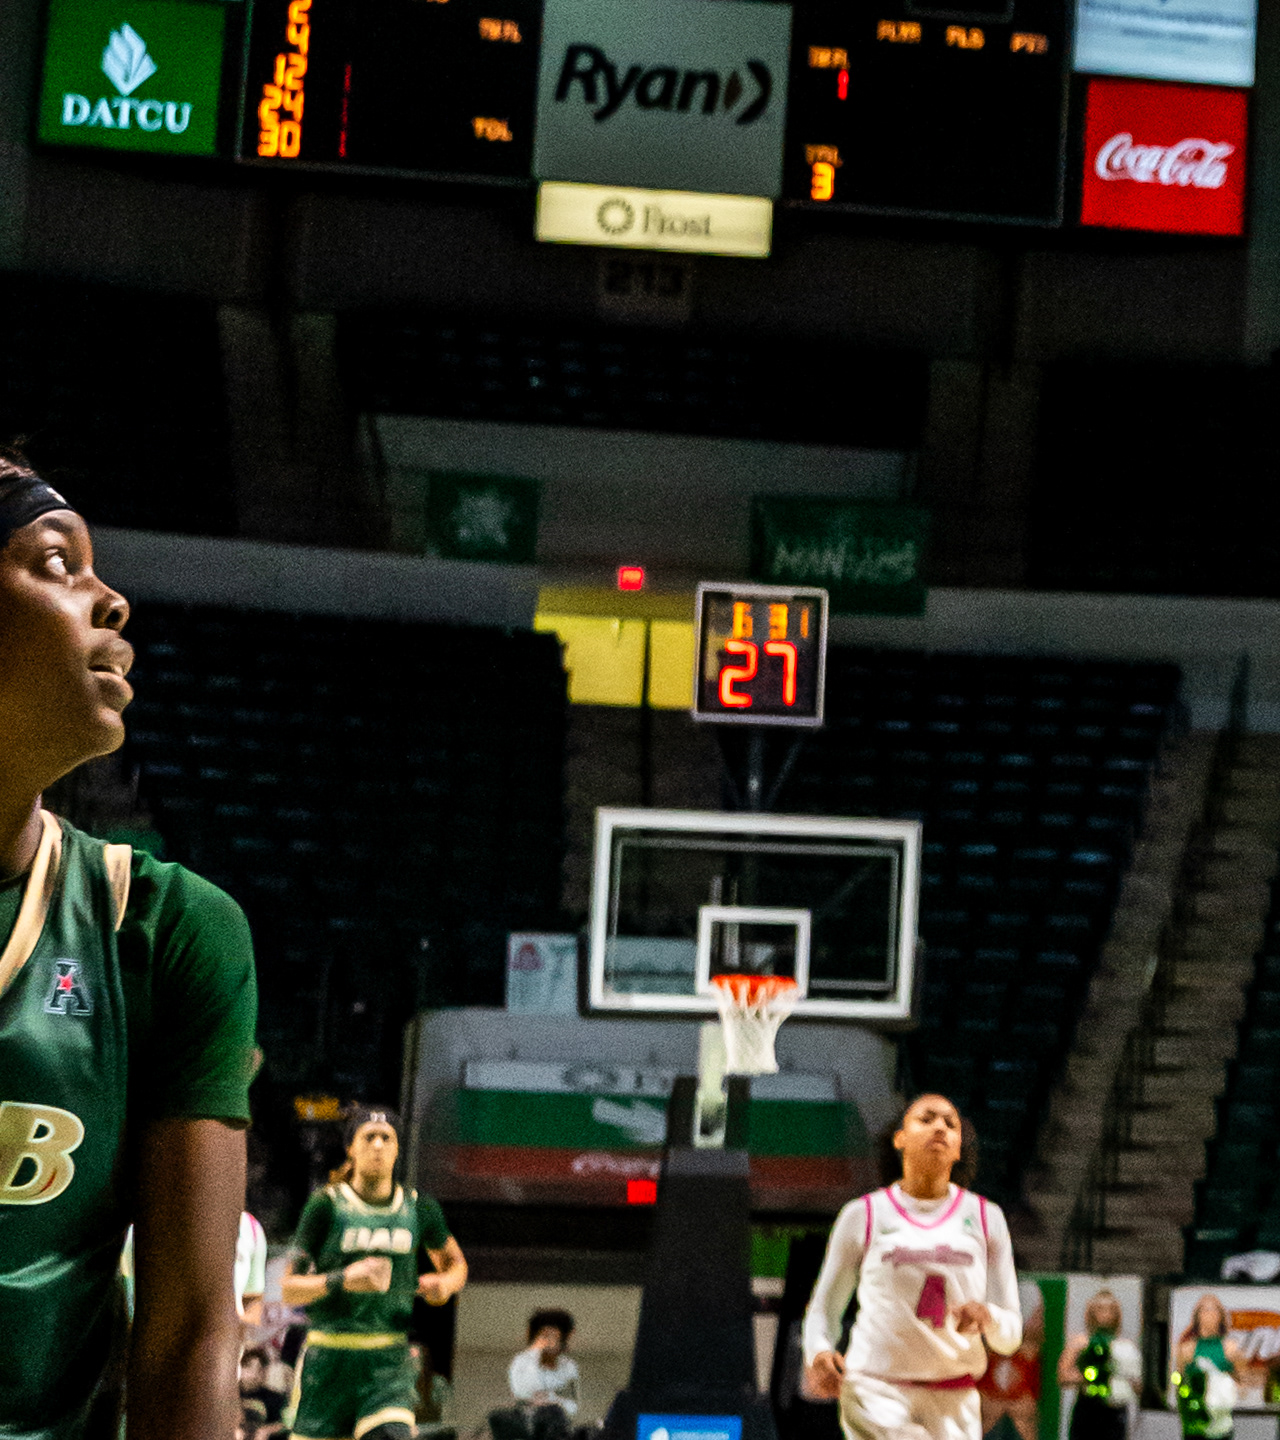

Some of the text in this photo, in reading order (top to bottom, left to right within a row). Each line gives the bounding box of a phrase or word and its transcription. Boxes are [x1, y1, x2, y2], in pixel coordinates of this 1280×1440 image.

[60, 91, 192, 135] DATCU
[552, 41, 722, 125] Ryan
[718, 638, 799, 708] 27
